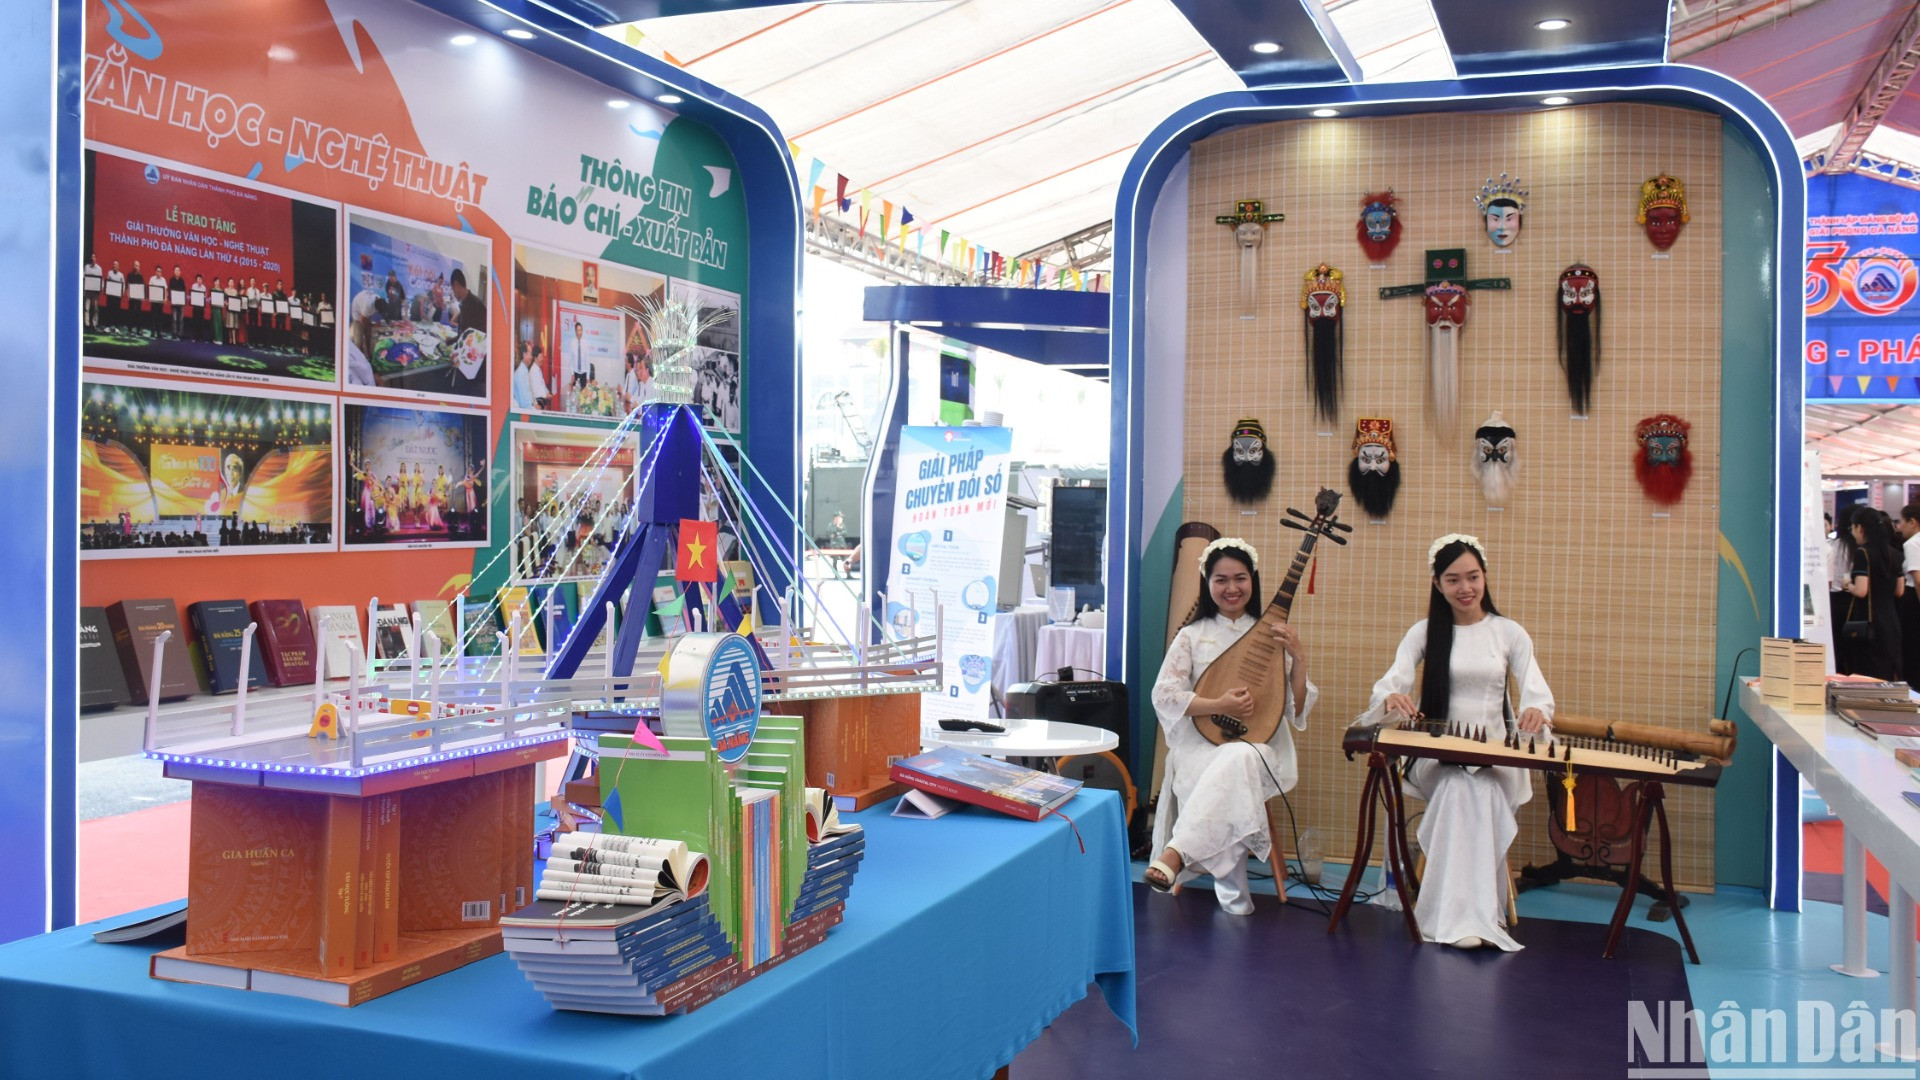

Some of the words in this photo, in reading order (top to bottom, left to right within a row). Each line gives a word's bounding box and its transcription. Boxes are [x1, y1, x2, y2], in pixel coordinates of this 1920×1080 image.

[168, 81, 265, 148] HỌC
[288, 117, 389, 190] NGHỆ
[394, 148, 488, 212] THUẬT
[580, 153, 656, 205] THÔNG
[659, 179, 692, 217] TIN
[166, 205, 178, 222] LỄ
[181, 212, 208, 228] TRAO
[209, 216, 236, 234] TẶNG
[527, 184, 578, 225] BÁO
[584, 203, 620, 240] CHÍ
[633, 214, 688, 258] XUẤT
[689, 227, 727, 271] BẢN
[109, 232, 139, 246] THÀNH
[142, 238, 159, 250] PHỐ
[161, 241, 173, 253] ĐÀ
[233, 255, 239, 264] 4
[239, 257, 258, 268] (2015
[126, 220, 144, 232] GIẢI
[146, 224, 181, 239] THƯỞNG
[183, 231, 199, 243] VĂN
[201, 235, 217, 247] HỌC
[224, 240, 244, 253] NGHỆ
[245, 244, 269, 257] THUẬT
[919, 452, 945, 481] GIẢI
[948, 445, 984, 475] PHÁP
[905, 479, 955, 510] CHUYỂN
[958, 473, 981, 500] ĐỔI
[984, 463, 1003, 495] SỐ
[913, 508, 937, 523] HOÀN
[944, 504, 970, 518] TOÀN
[977, 498, 997, 514] MỚI
[717, 734, 728, 752] ĐÀ
[222, 850, 242, 860] GIA
[245, 847, 278, 859] HUẤN
[280, 848, 295, 857] CA
